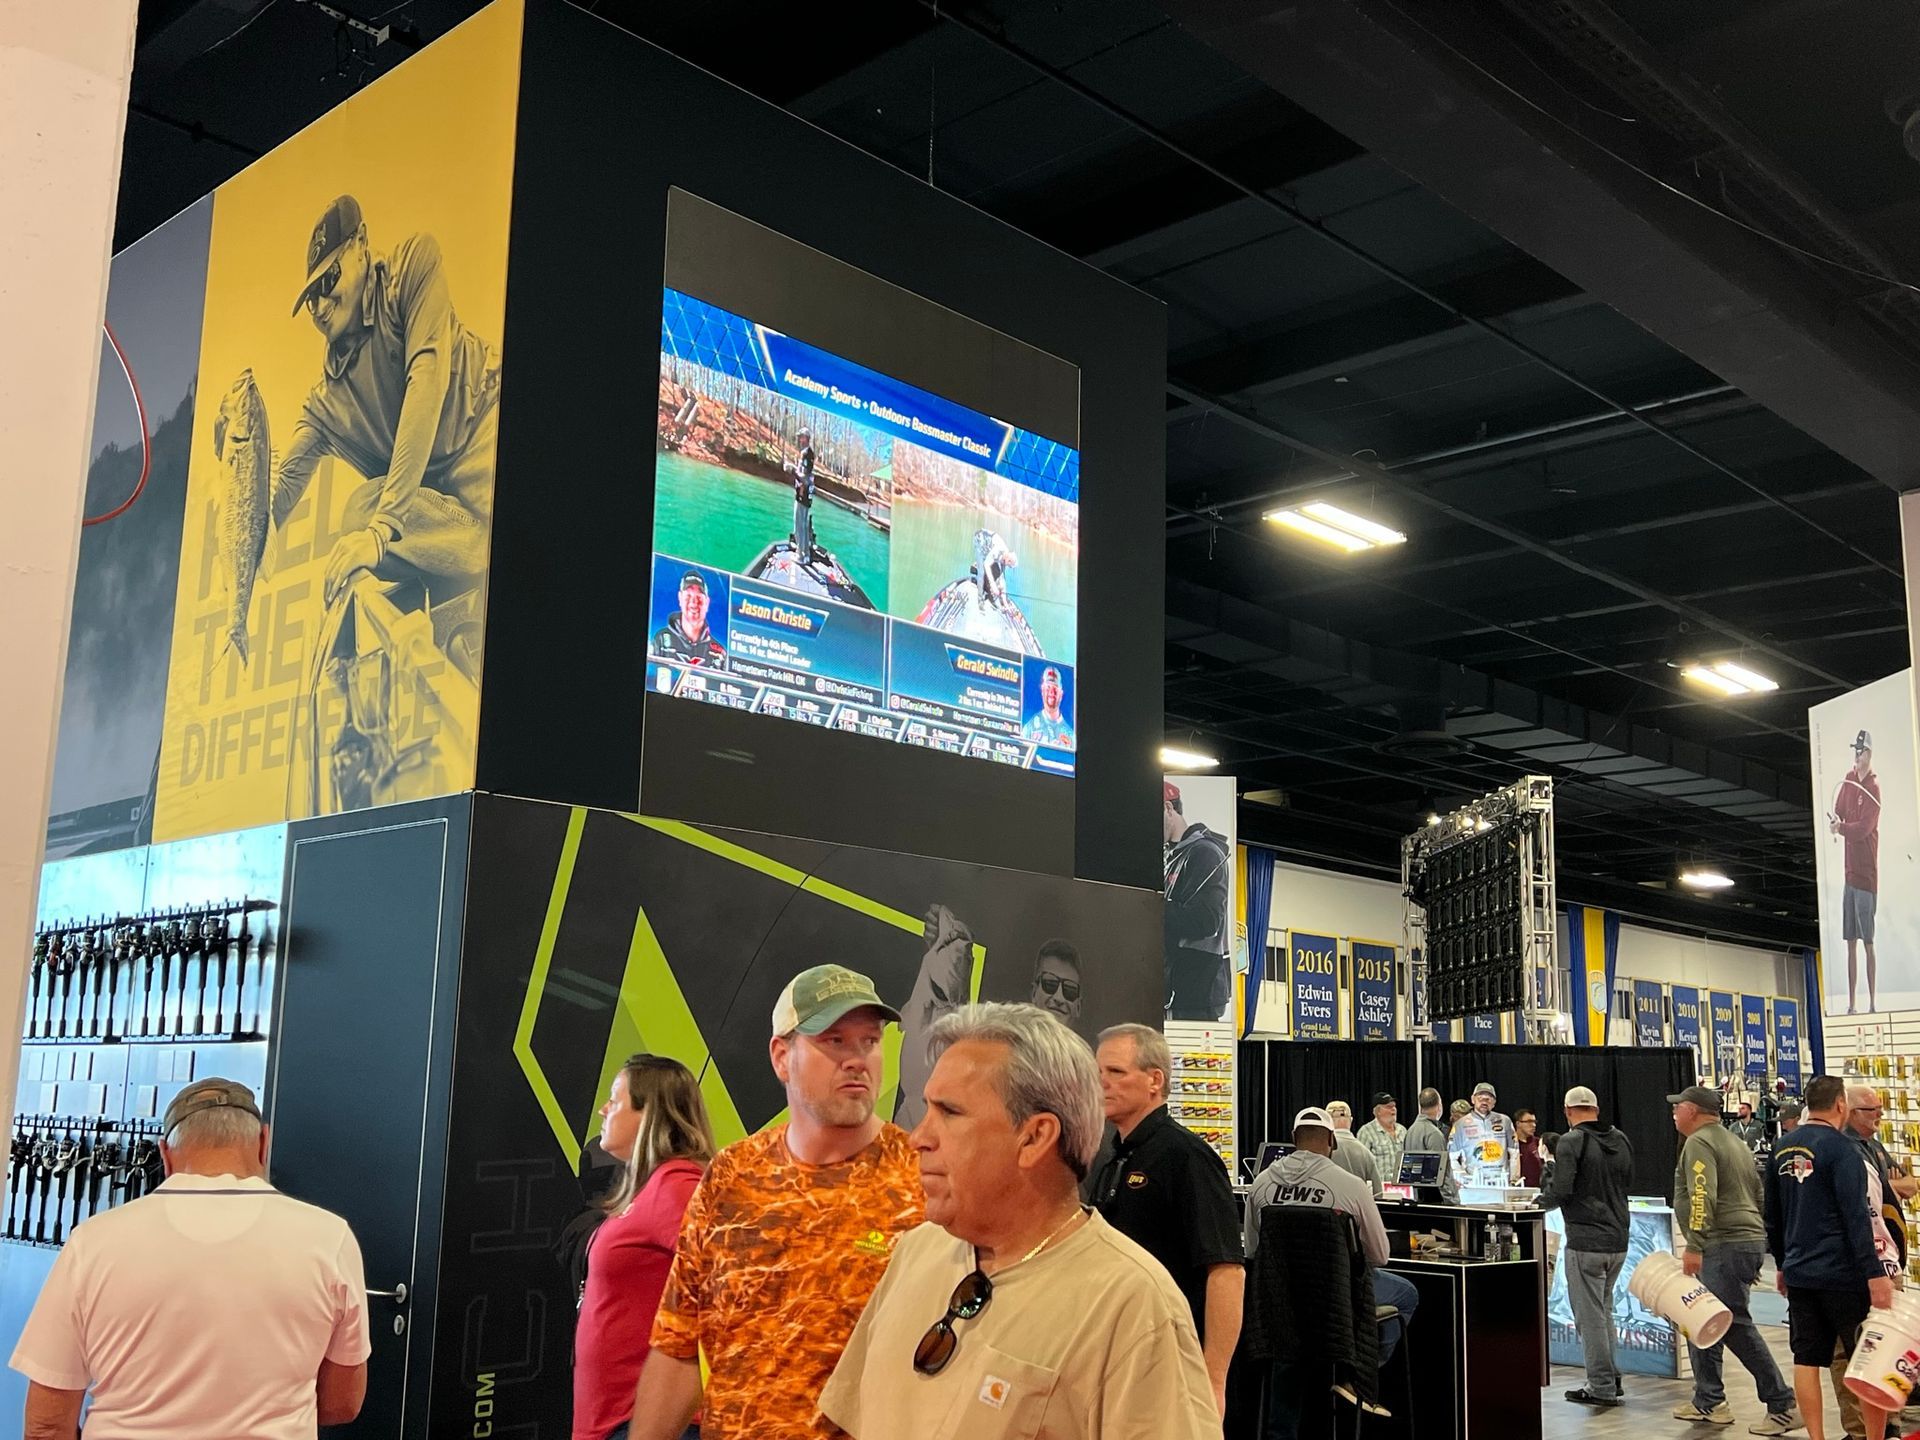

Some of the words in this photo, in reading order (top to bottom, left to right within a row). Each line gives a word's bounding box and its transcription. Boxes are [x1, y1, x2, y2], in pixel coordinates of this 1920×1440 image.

[784, 369, 829, 398] Academy
[831, 386, 862, 409] Sports
[870, 401, 911, 428] Outdoors
[912, 417, 962, 445] Bassmaster
[962, 436, 992, 458] Classic
[739, 599, 770, 619] Jason
[772, 607, 811, 630] Christie
[194, 580, 311, 706] THE
[730, 629, 761, 647] Currently
[780, 641, 799, 656] Place
[766, 649, 788, 663] Behind
[789, 654, 811, 668] Leader
[767, 668, 782, 680] Park
[957, 654, 985, 674] Gerald
[986, 662, 1018, 682] Swindle
[688, 687, 703, 700] Fish
[768, 704, 783, 716] Fish
[1296, 949, 1333, 975] 2016
[1358, 958, 1391, 983] 2015
[1298, 984, 1333, 1001] Edwin
[1360, 991, 1390, 1010] Casey
[1301, 1002, 1331, 1018] Evers
[1639, 998, 1659, 1014] 2011
[1678, 1003, 1697, 1019] 2010
[1358, 1007, 1393, 1026] Ashley
[1474, 1015, 1493, 1029] Pace
[1301, 1022, 1318, 1031] Grand
[1319, 1023, 1332, 1032] Lake
[1301, 1030, 1310, 1038] the
[1368, 1027, 1382, 1036] Lake
[1641, 1024, 1660, 1038] Kevin
[1678, 1030, 1698, 1044] Kevin
[1746, 1035, 1764, 1049] Alton
[1747, 1049, 1765, 1065] Jones
[1694, 1174, 1707, 1231] Columbia
